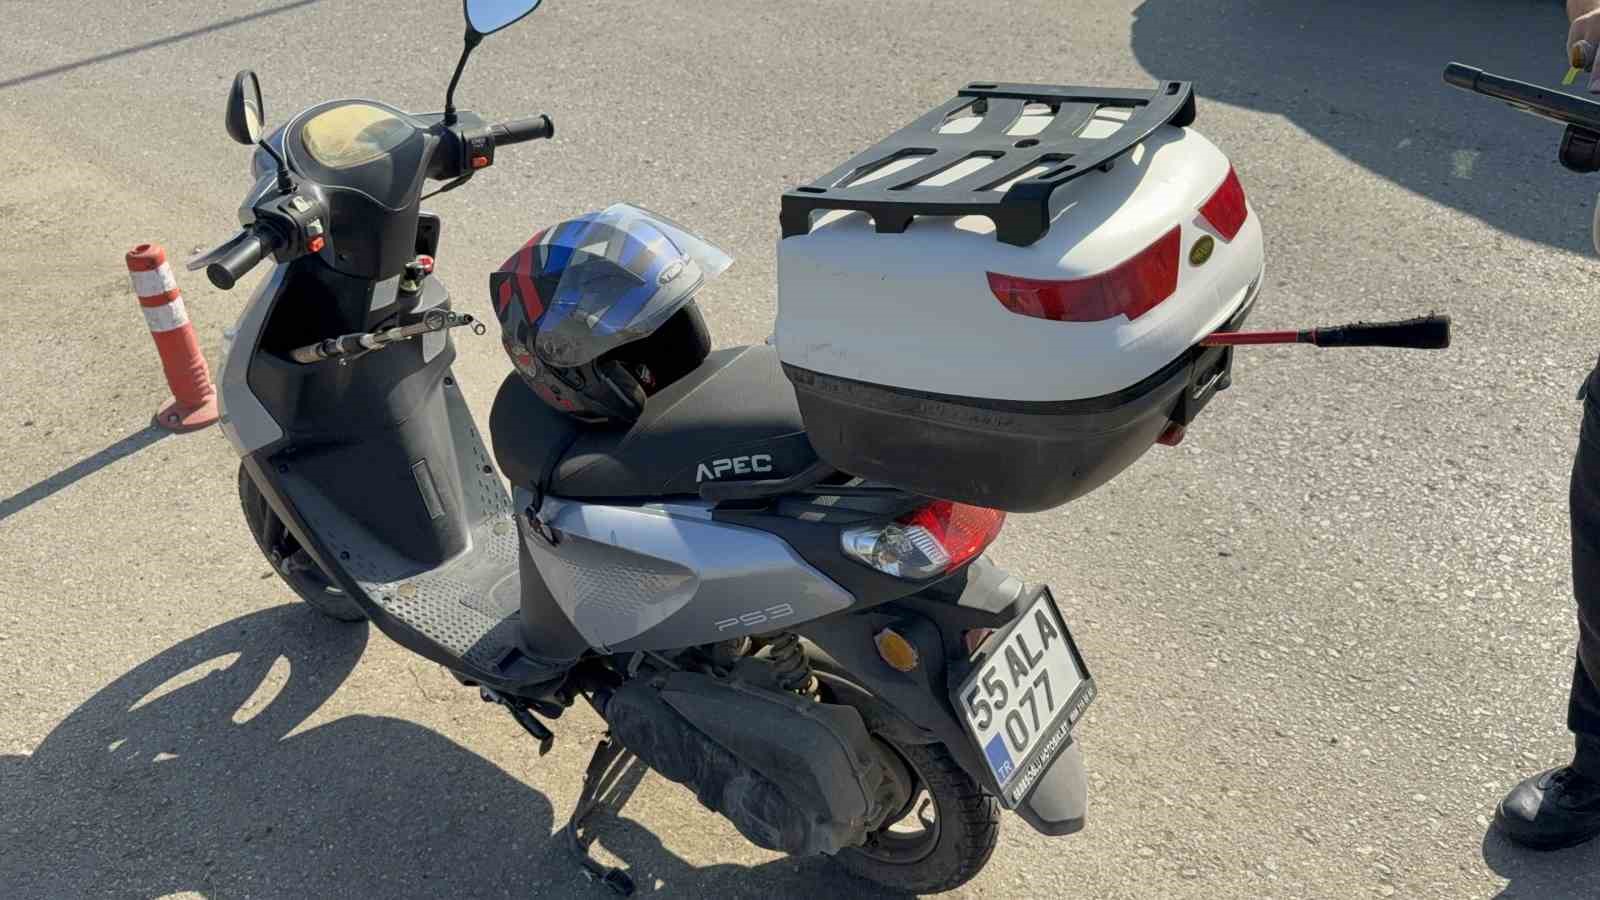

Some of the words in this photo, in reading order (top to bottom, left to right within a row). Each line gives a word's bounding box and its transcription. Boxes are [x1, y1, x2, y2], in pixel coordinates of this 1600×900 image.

[696, 454, 772, 482] APEC
[714, 603, 794, 632] PS3
[966, 665, 1009, 732] 55
[1005, 609, 1058, 688] ALA
[1005, 668, 1055, 752] 077
[998, 759, 1015, 779] TR
